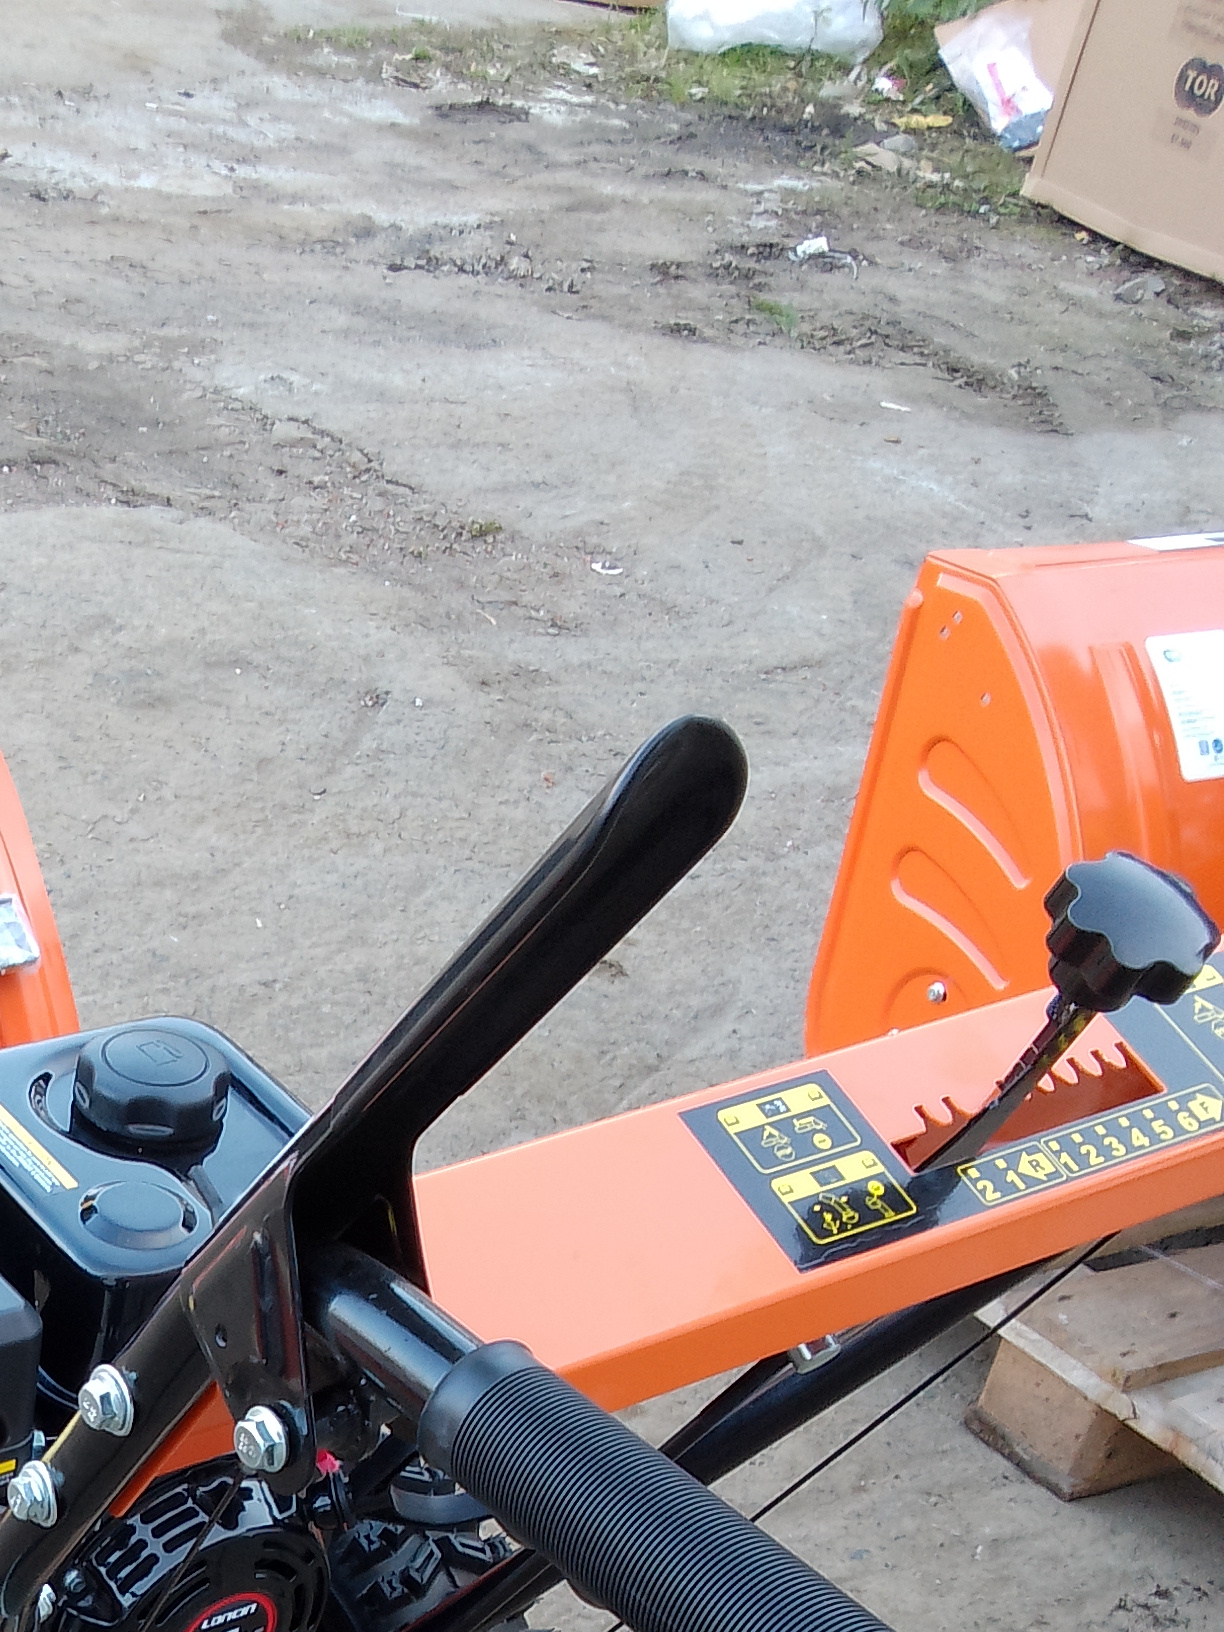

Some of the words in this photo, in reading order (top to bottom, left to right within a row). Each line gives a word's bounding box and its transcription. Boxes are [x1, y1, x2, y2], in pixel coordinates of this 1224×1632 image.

[1184, 68, 1220, 101] TOR
[1059, 1151, 1080, 1172] 1
[1080, 1143, 1106, 1167] 2
[1103, 1135, 1127, 1158] 3
[1130, 1126, 1151, 1149] 4
[1150, 1118, 1175, 1141] 5
[1176, 1110, 1201, 1133] 6
[976, 1179, 1002, 1202] 2
[1005, 1169, 1026, 1191] 1
[1027, 1158, 1045, 1175] R
